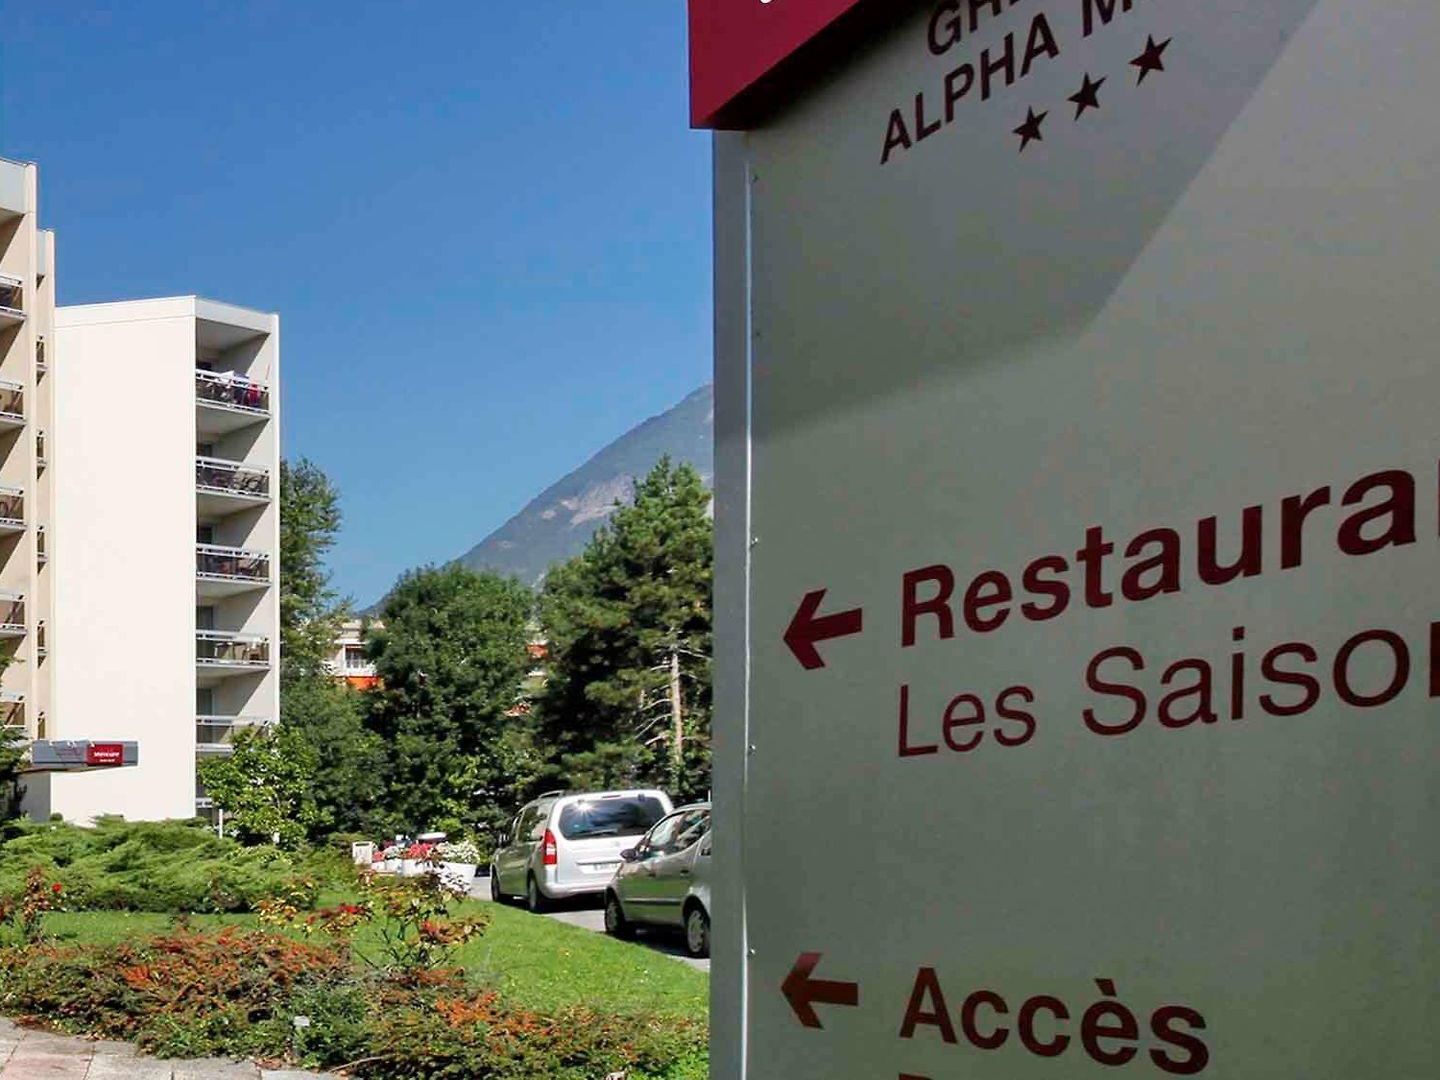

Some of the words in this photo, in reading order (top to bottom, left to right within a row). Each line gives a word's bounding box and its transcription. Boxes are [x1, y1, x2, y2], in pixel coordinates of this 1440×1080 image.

[880, 12, 1059, 165] ALPHA
[901, 458, 1440, 647] Restaura
[898, 684, 1036, 758] Les
[1082, 620, 1440, 736] Saiso
[899, 966, 1210, 1076] Accès
